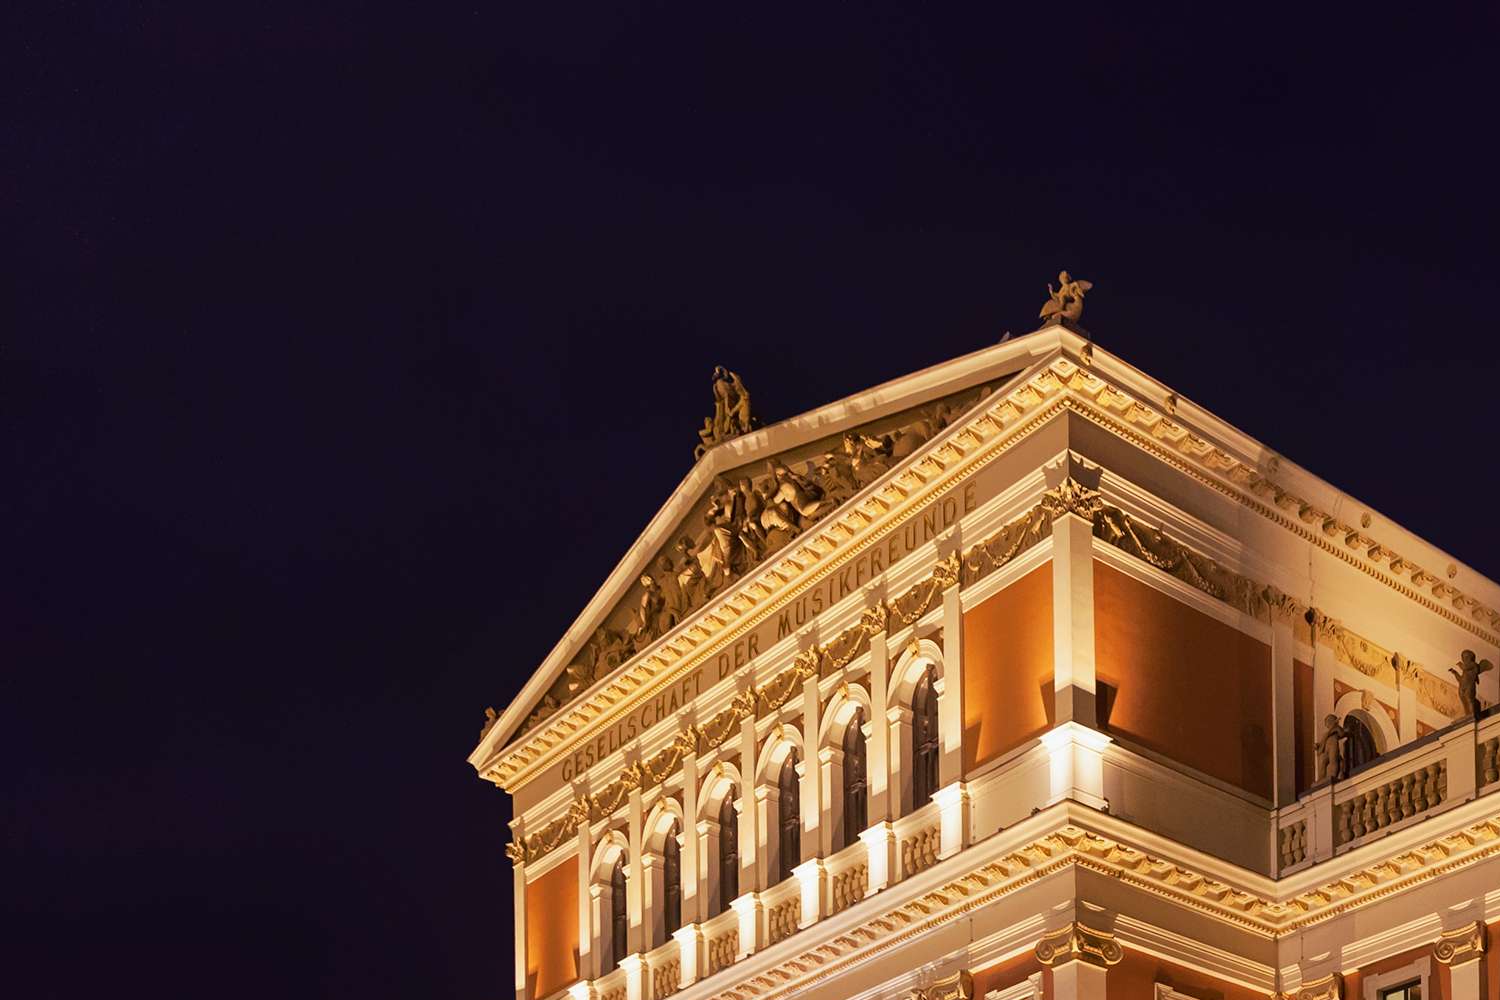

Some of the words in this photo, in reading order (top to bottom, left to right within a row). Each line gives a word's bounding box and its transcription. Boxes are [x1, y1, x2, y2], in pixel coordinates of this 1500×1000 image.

[561, 671, 703, 782] GESELLSCHAFT
[718, 632, 760, 681] DER
[776, 480, 977, 641] MUSIKFREUNDE
